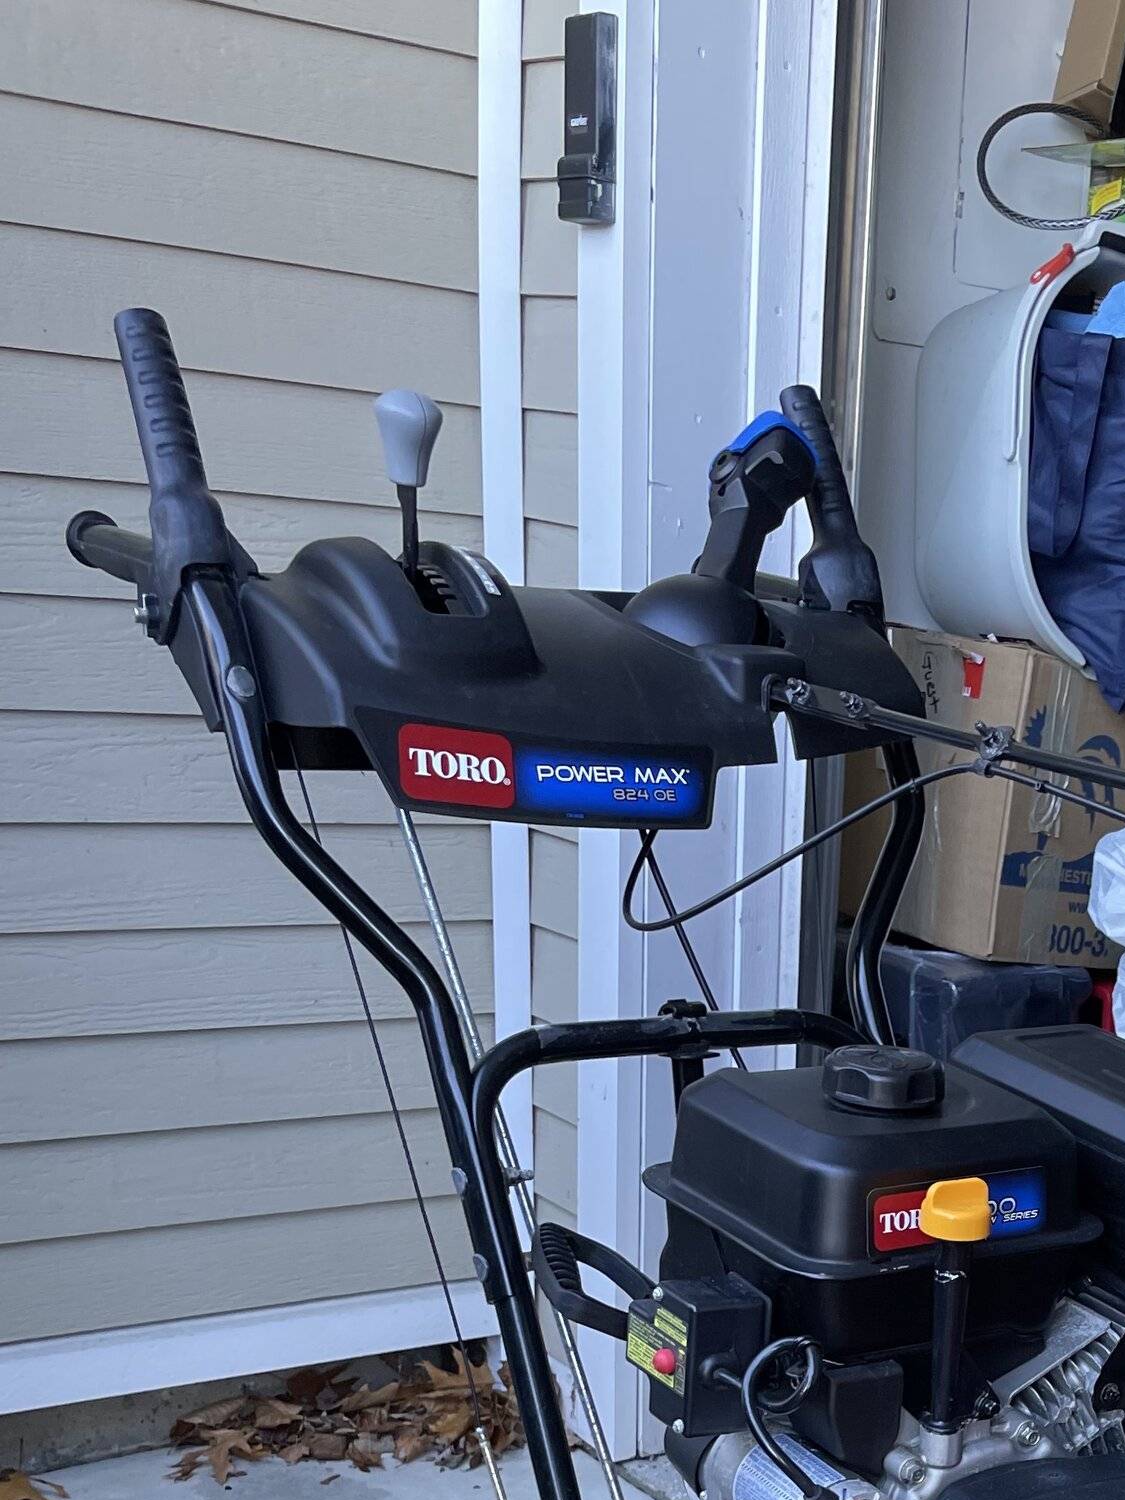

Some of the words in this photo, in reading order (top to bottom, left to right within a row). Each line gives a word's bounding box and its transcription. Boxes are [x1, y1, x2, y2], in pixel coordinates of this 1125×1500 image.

[408, 746, 507, 786] TORO
[536, 765, 625, 783] POWER
[634, 767, 690, 785] MAX
[612, 788, 649, 801] 824
[879, 1208, 921, 1234] TOR
[1002, 1208, 1040, 1223] SERIES
